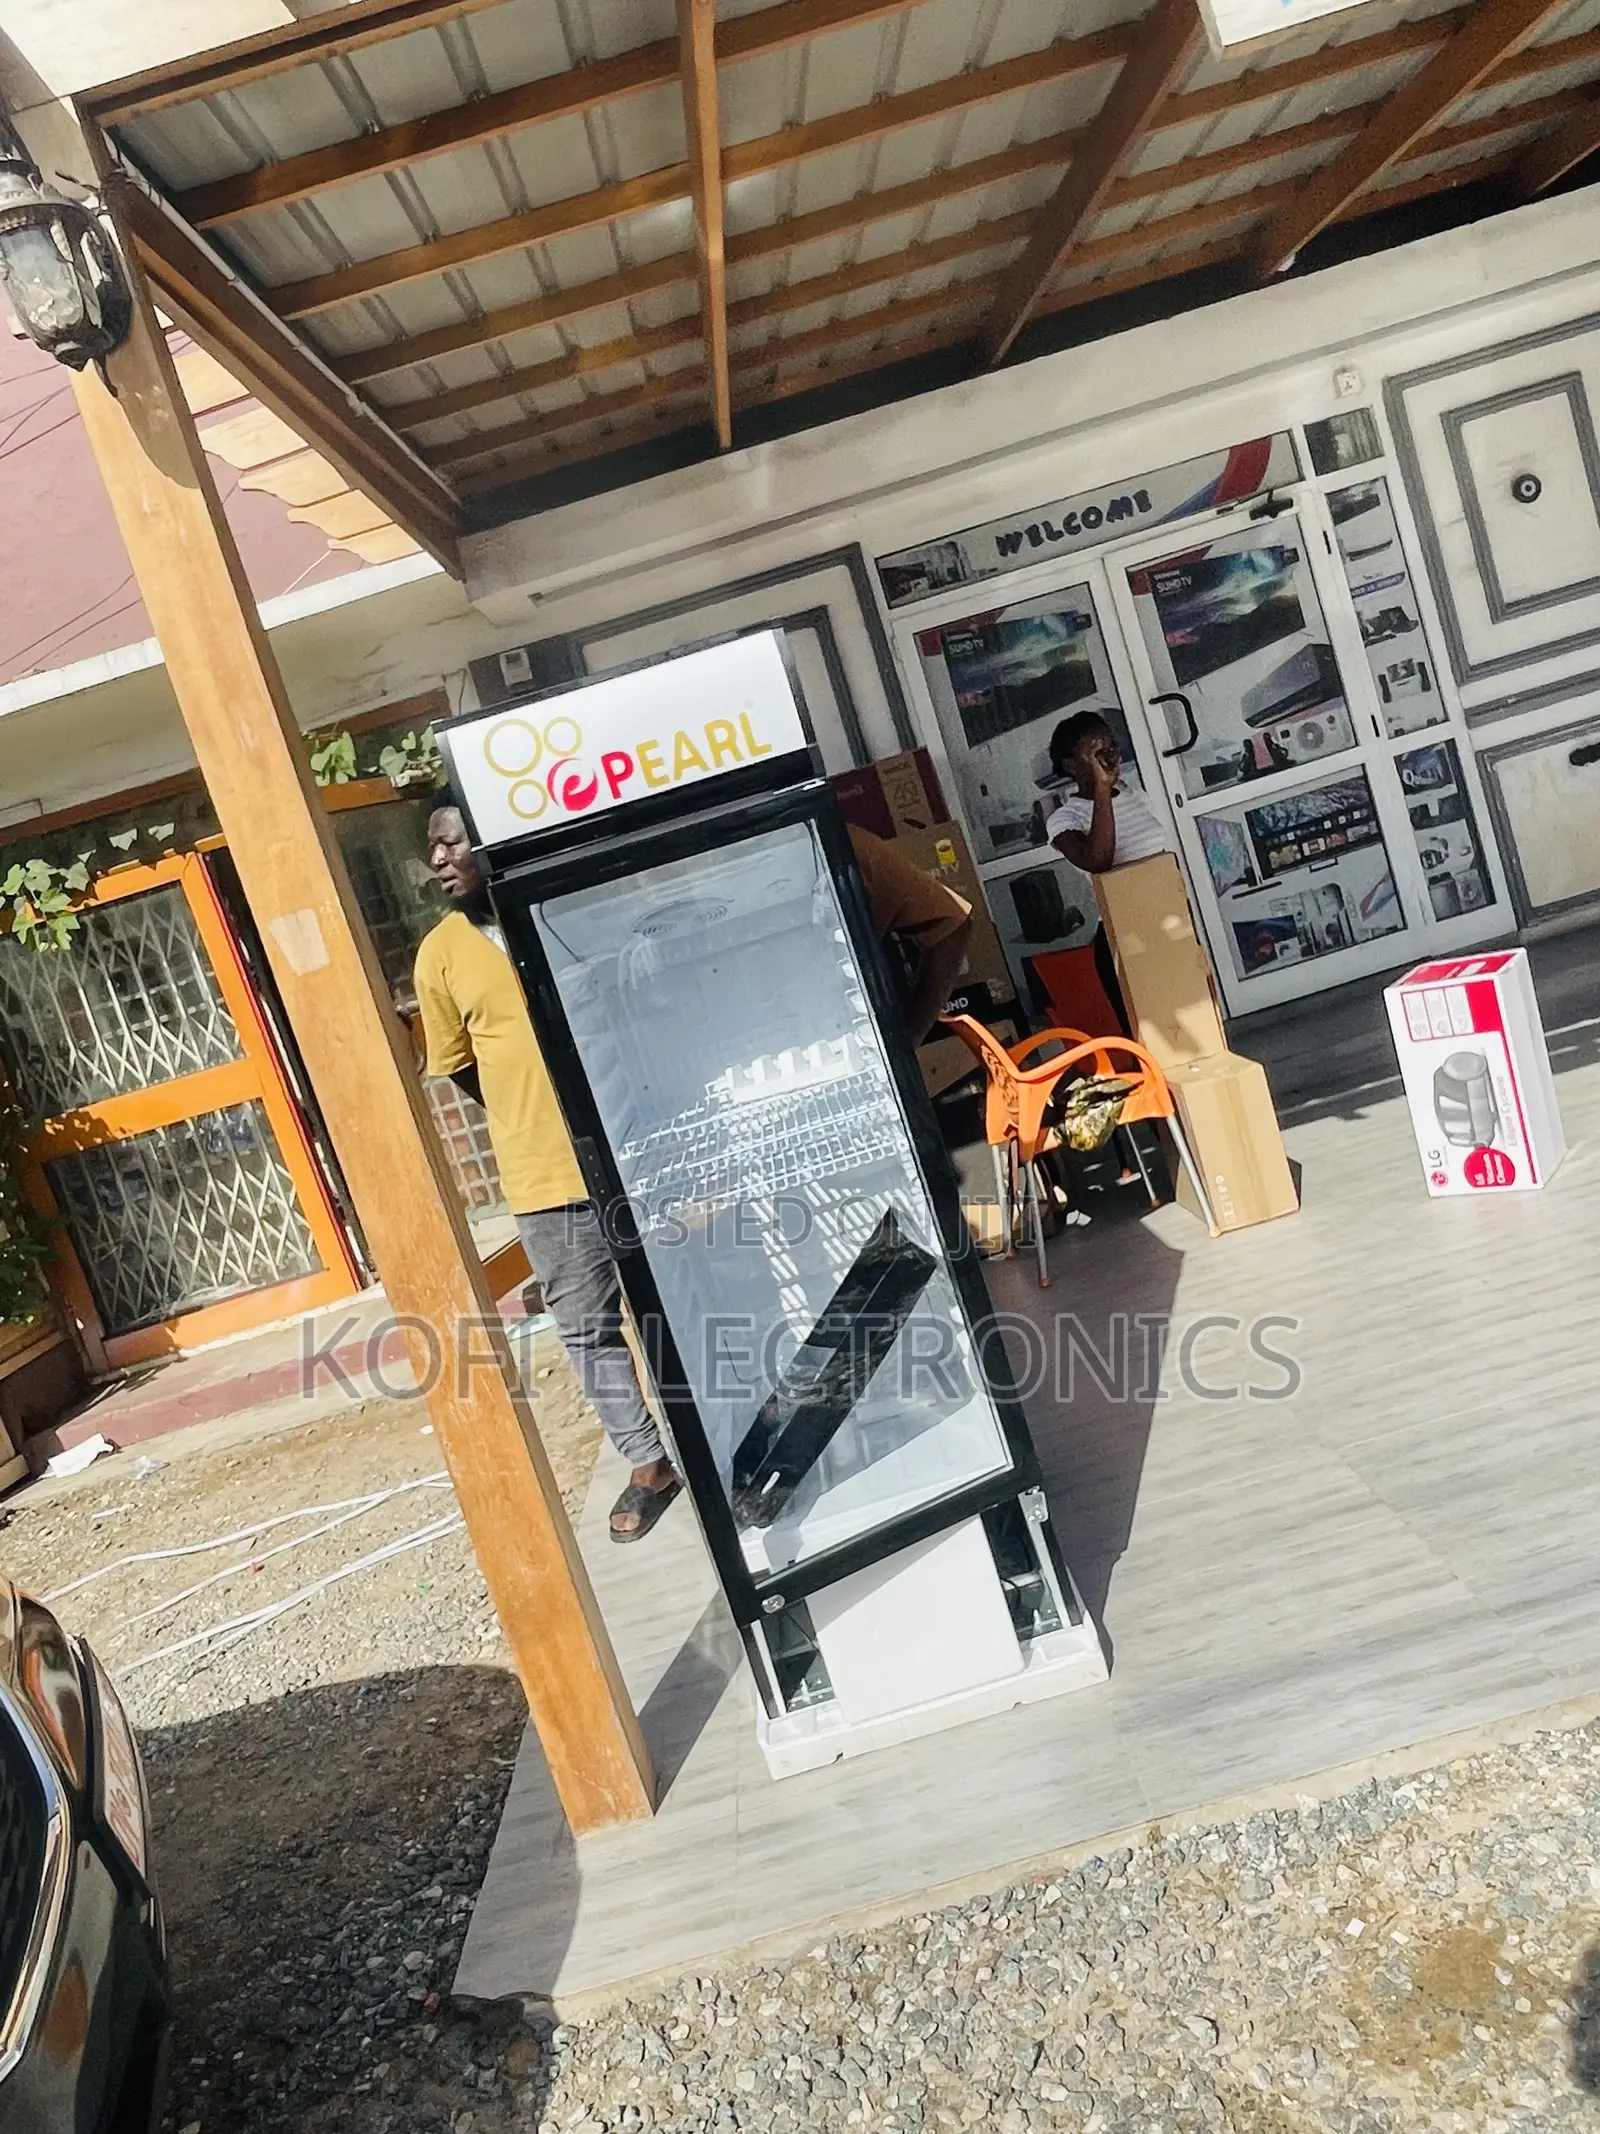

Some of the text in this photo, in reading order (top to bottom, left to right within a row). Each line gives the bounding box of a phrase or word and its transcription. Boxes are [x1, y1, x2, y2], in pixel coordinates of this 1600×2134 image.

[995, 490, 1153, 557] WELCOME
[600, 712, 772, 800] PEARL
[1428, 1150, 1442, 1168] LG
